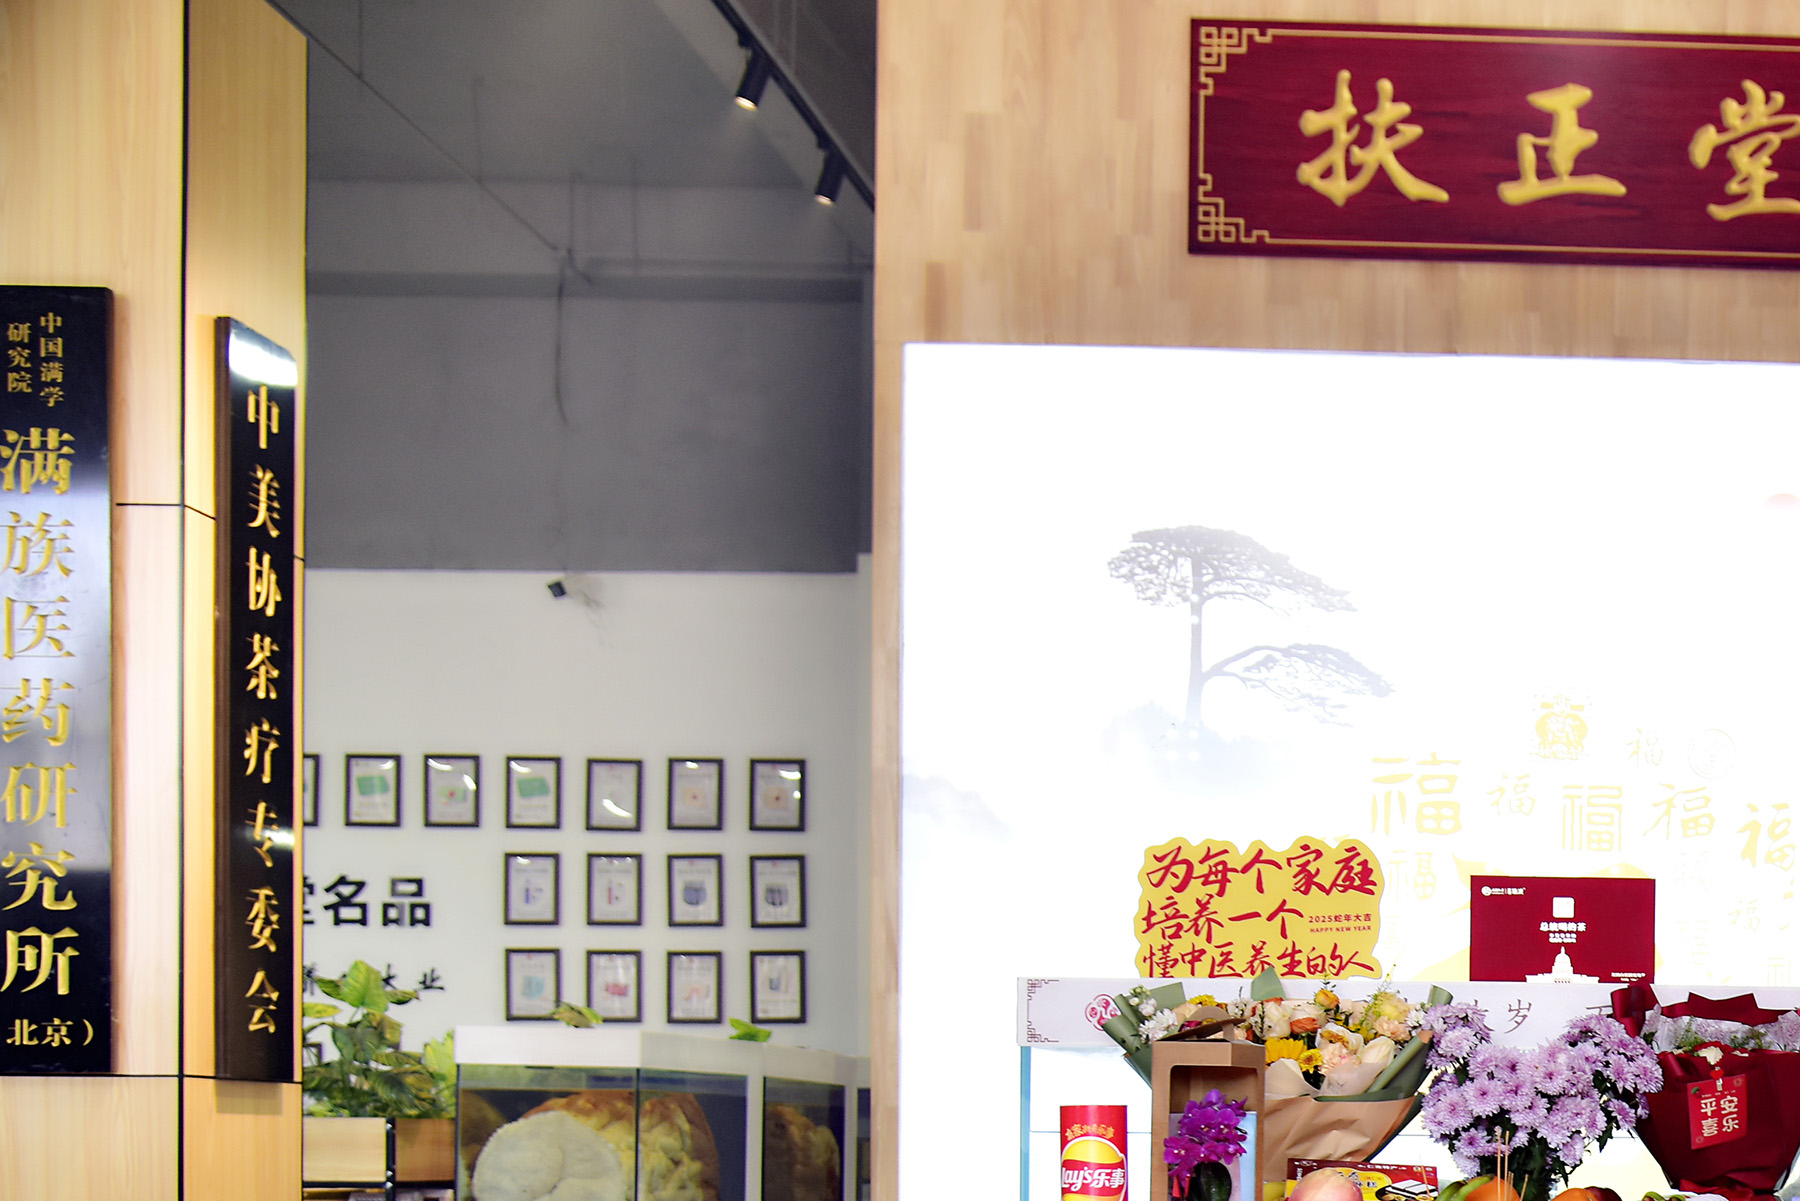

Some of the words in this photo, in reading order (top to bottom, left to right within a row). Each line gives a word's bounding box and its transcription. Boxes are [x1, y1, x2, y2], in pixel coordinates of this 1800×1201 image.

[6, 322, 33, 394] 研究院
[38, 311, 66, 408] 中国满学
[0, 426, 80, 997] 满族医药研究所
[244, 384, 283, 1036] 中美协茶疗专委会
[1146, 843, 1378, 898] 为每个家庭
[303, 873, 432, 927] 名品
[1141, 893, 1304, 944] 培养一个
[1309, 926, 1334, 934] HAPPY
[1353, 925, 1373, 933] YEAR
[1143, 940, 1375, 978] 懂中医养生的人
[1700, 1095, 1739, 1116] 平安
[1701, 1114, 1740, 1138] 喜乐
